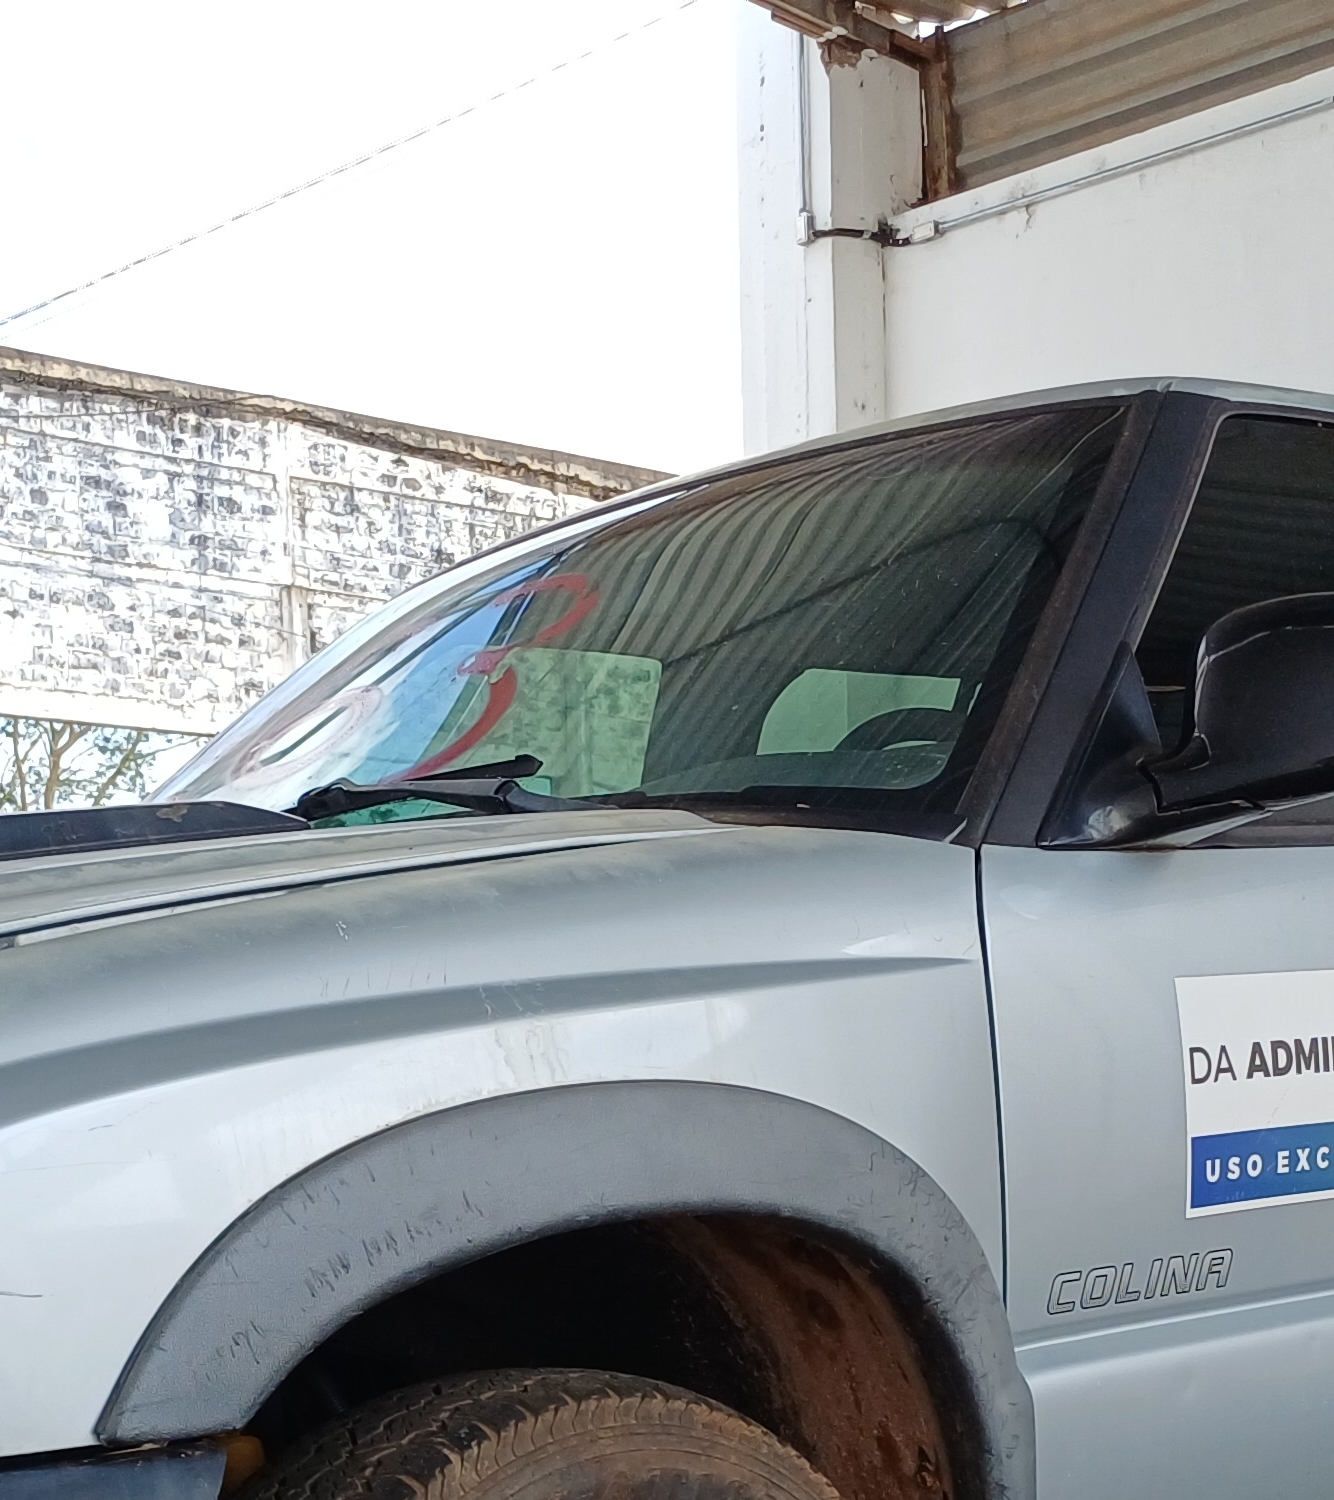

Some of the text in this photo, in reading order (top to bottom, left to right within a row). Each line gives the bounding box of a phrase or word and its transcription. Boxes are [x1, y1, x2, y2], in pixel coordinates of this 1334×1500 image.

[1188, 1046, 1238, 1085] DA
[1205, 1155, 1263, 1183] USO
[1046, 1248, 1234, 1316] COLINA
